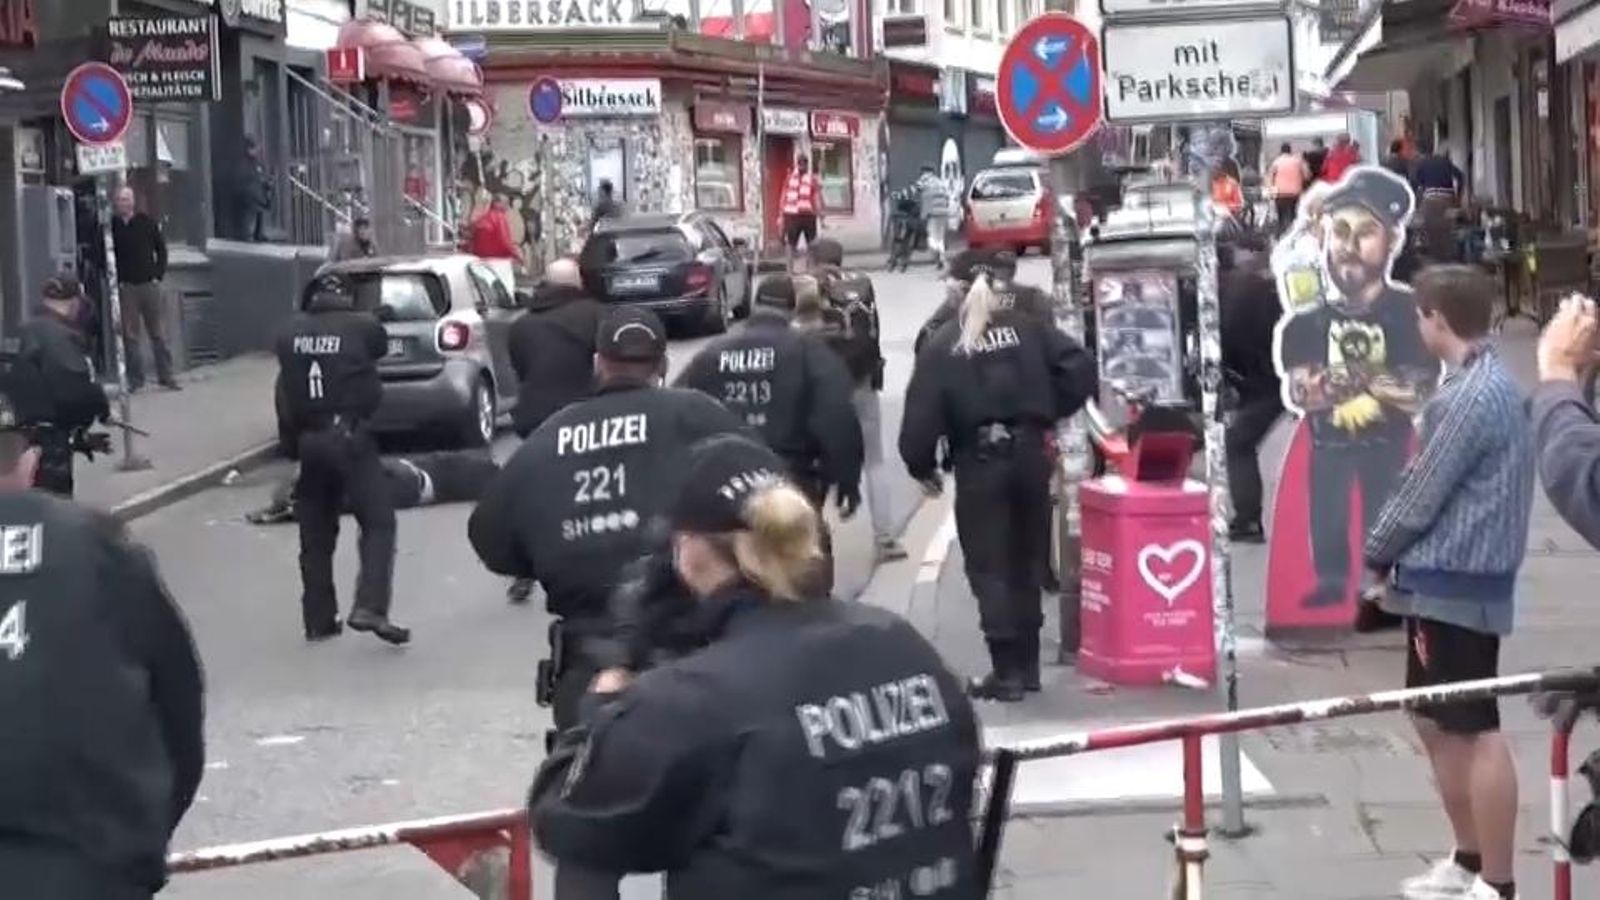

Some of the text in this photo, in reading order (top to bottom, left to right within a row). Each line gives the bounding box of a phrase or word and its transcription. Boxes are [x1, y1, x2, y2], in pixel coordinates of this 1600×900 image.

[455, 0, 624, 25] ILBERSACK
[108, 18, 208, 36] RESTAURANT
[1173, 40, 1219, 66] mit
[161, 69, 205, 82] FLEISCH
[1117, 70, 1279, 102] Parksche
[132, 84, 202, 97] EZIALITÄTEN
[561, 86, 656, 106] Silbersack
[293, 335, 341, 354] POLIZEI
[719, 347, 775, 373] POLIZEI
[558, 413, 647, 455] POLIZEI
[573, 462, 625, 502] 221
[0, 523, 43, 573] EI
[795, 673, 950, 758] POLIZEI
[836, 764, 952, 851] 2212
